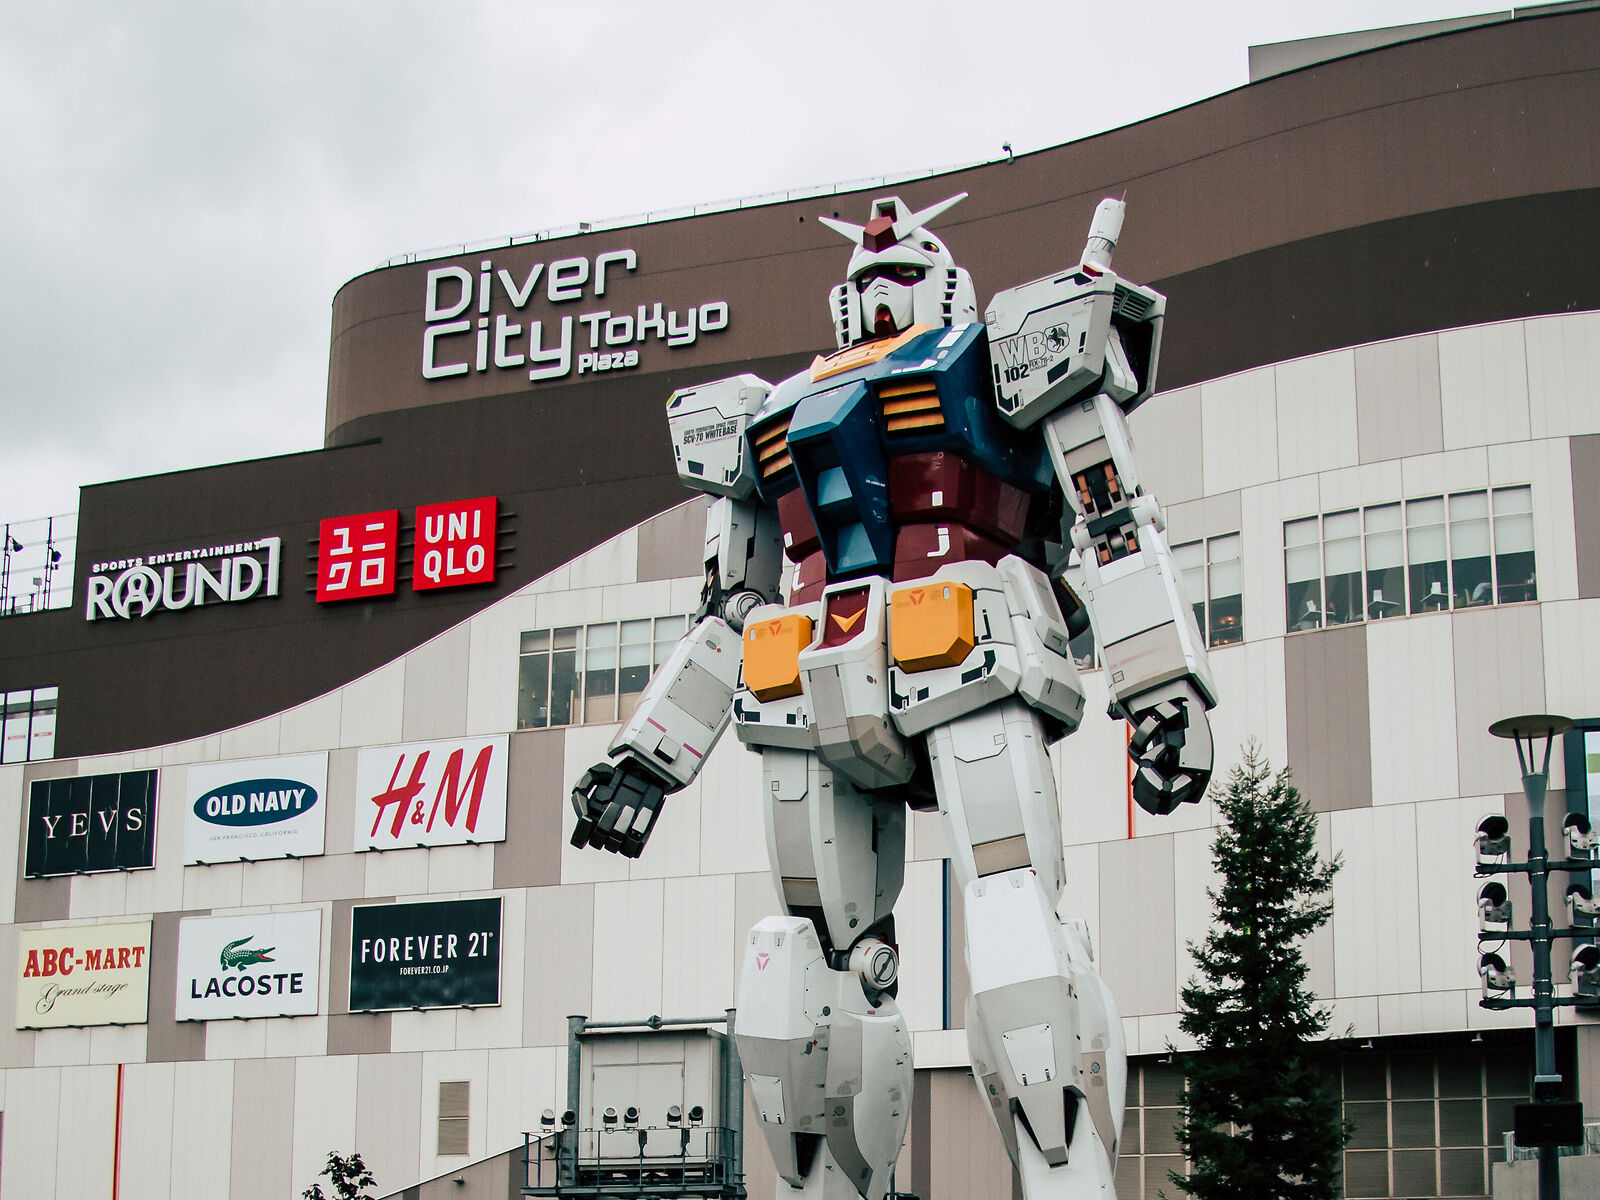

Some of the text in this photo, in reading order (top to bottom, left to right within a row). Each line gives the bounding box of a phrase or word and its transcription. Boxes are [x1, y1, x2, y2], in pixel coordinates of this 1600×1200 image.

[425, 249, 637, 322] Diver
[422, 301, 728, 381] City Tokyo
[999, 331, 1047, 368] WB
[578, 350, 639, 374] Plaza
[1004, 364, 1030, 383] 102
[424, 510, 482, 544] UNI
[93, 541, 262, 573] SPORTS ENTERTAINMENT
[423, 544, 485, 584] QLO
[206, 788, 306, 817] OLD NAVY
[370, 745, 495, 839] H&M
[42, 807, 143, 840] YEVS
[23, 946, 145, 979] ABC-MART
[361, 934, 458, 964] FOREVER
[191, 972, 304, 999] LACOSTE
[400, 965, 450, 976] FOREVER21.CO.JP
[35, 981, 129, 1015] Grand stage
